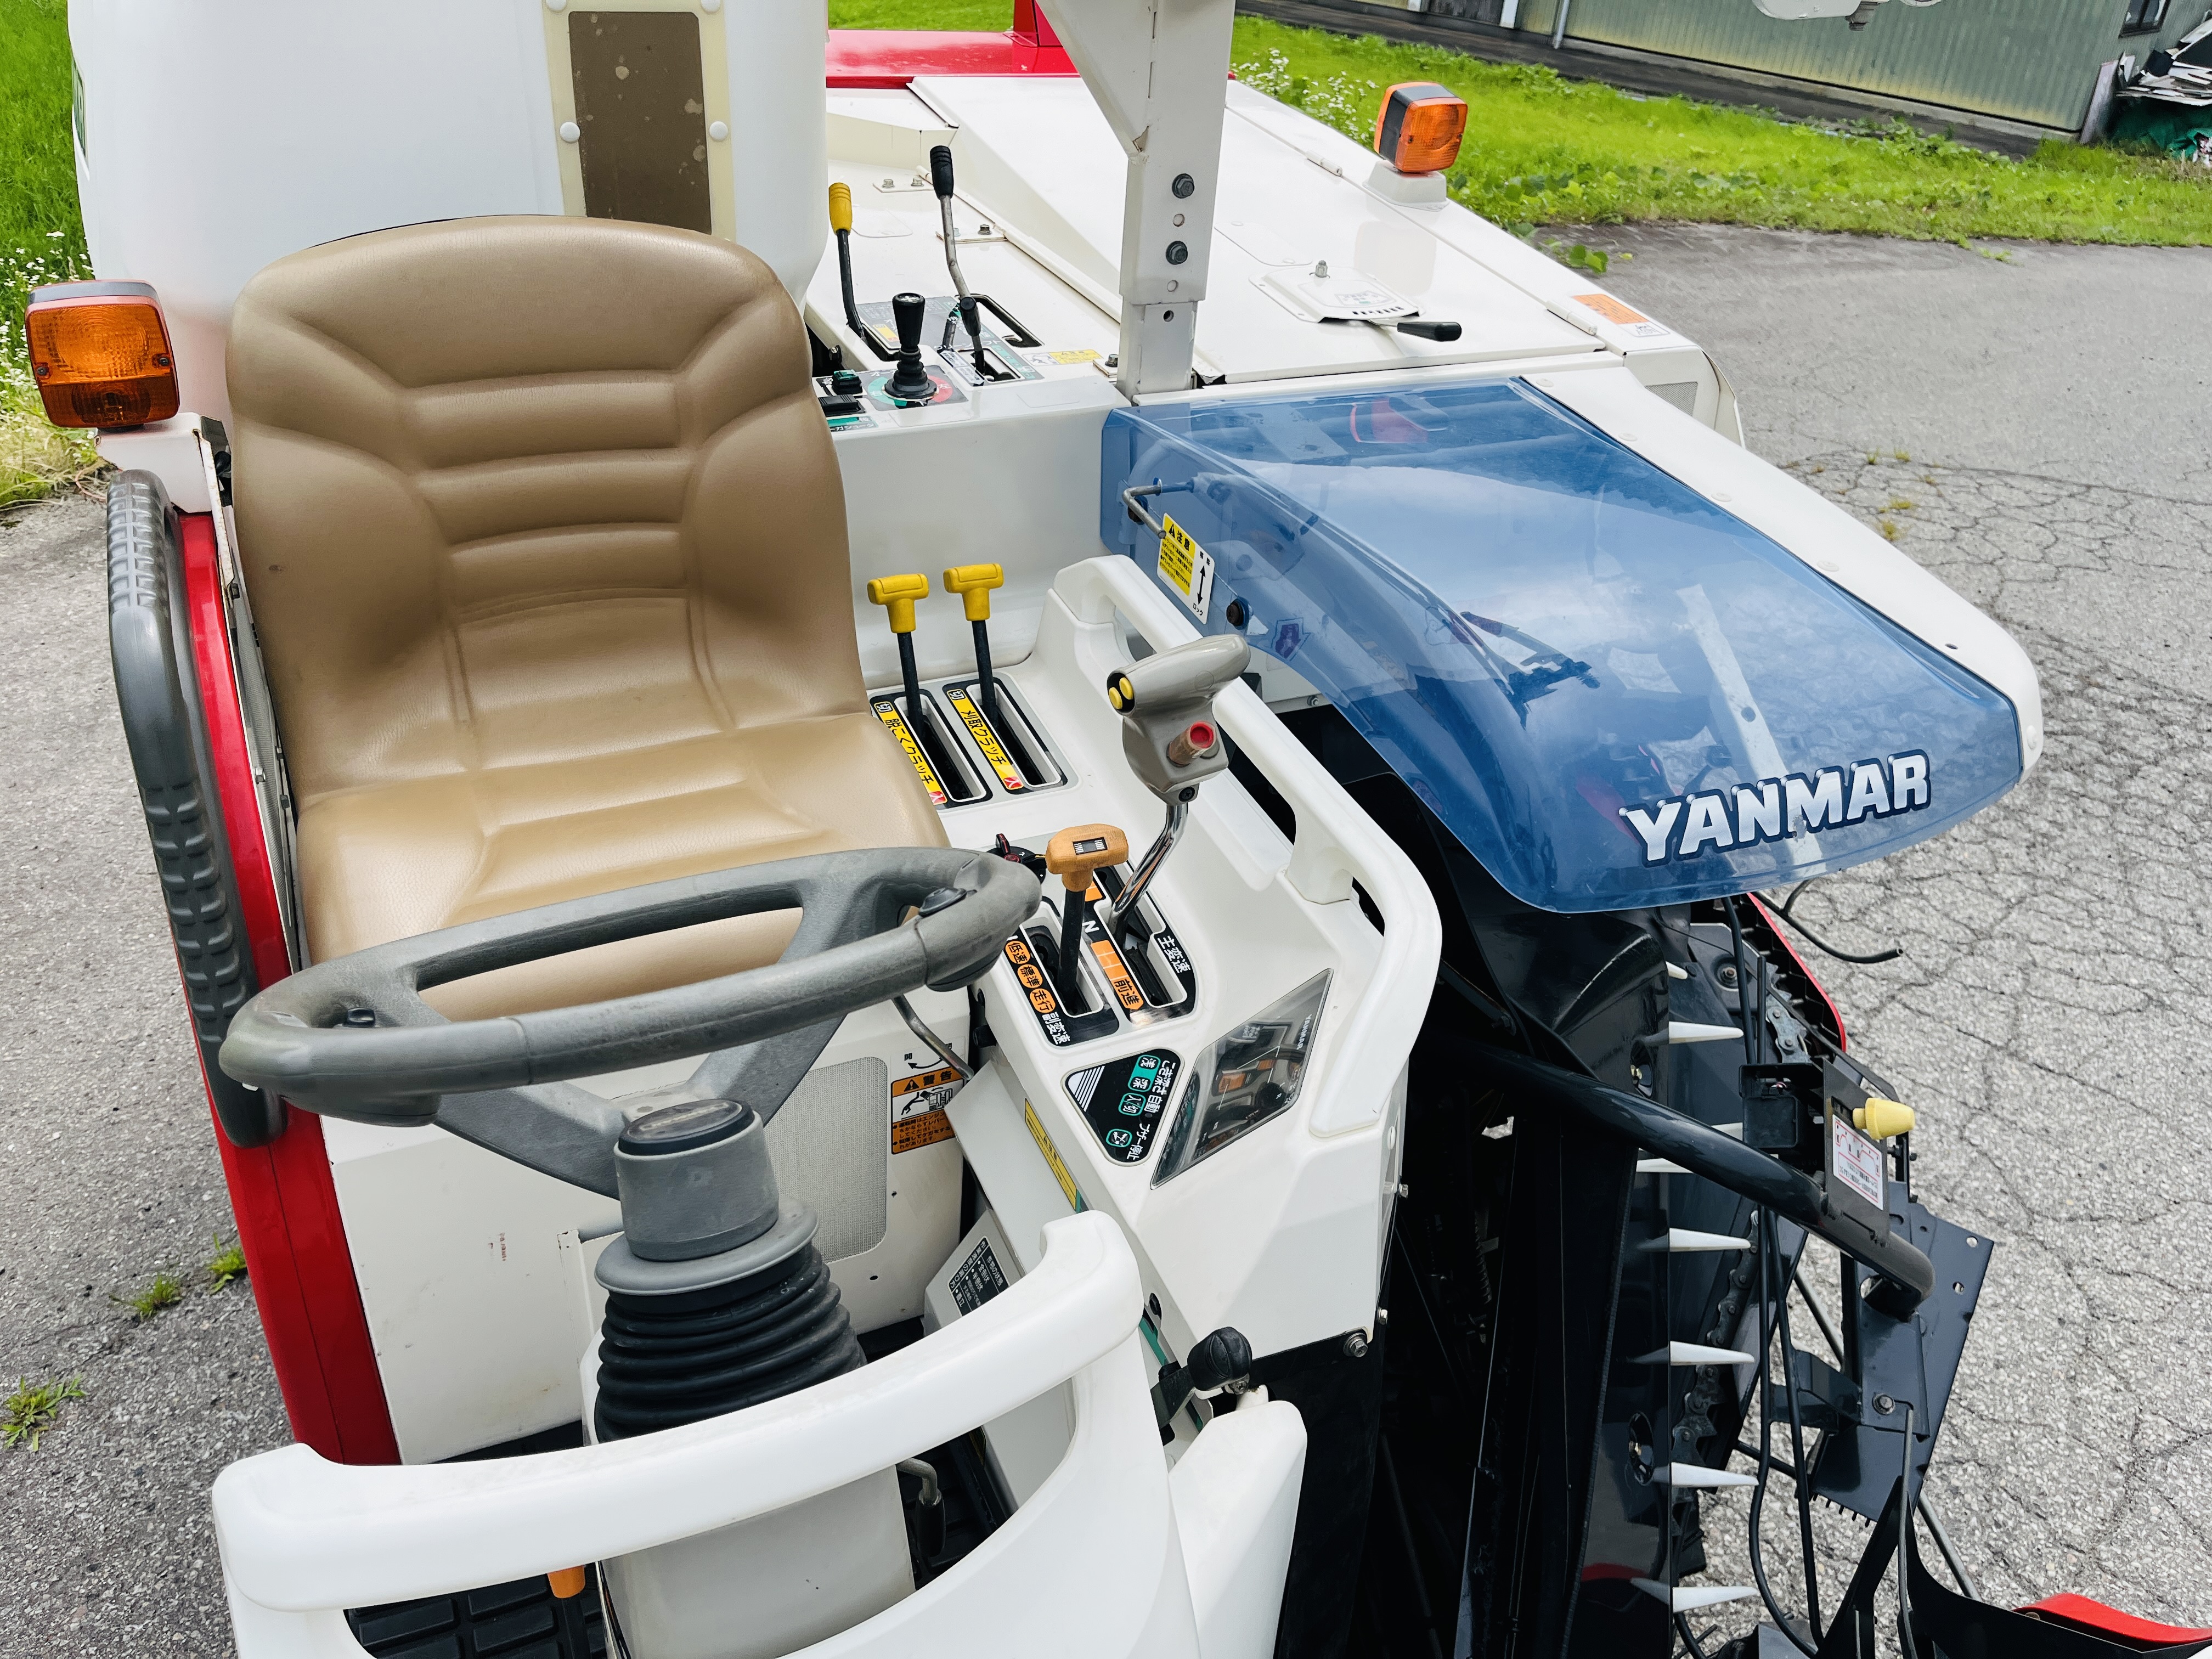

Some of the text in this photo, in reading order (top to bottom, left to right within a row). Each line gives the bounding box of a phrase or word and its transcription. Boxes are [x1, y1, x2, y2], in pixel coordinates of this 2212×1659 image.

[1177, 530, 1190, 551] 注意
[1193, 602, 1204, 616] ロック
[949, 689, 965, 700] 切
[876, 702, 893, 713] 切
[961, 709, 1007, 766] 刈取クラッチ
[884, 718, 935, 785] 脱こくクラッチ
[1005, 777, 1023, 788] 入
[1618, 749, 1931, 868] YANMAR
[1082, 920, 1100, 934] N
[1007, 941, 1029, 964] 低速
[1157, 935, 1191, 974] 主変速
[1019, 966, 1041, 988] 標準
[1031, 989, 1053, 1012] 走行
[1113, 978, 1141, 1007] 前進
[1041, 1011, 1071, 1045] 副変速
[1296, 1013, 1313, 1050] YANMAR
[1140, 1057, 1156, 1068] 浅
[1132, 1077, 1149, 1089] 深
[1127, 1123, 1150, 1160] ブザー停止
